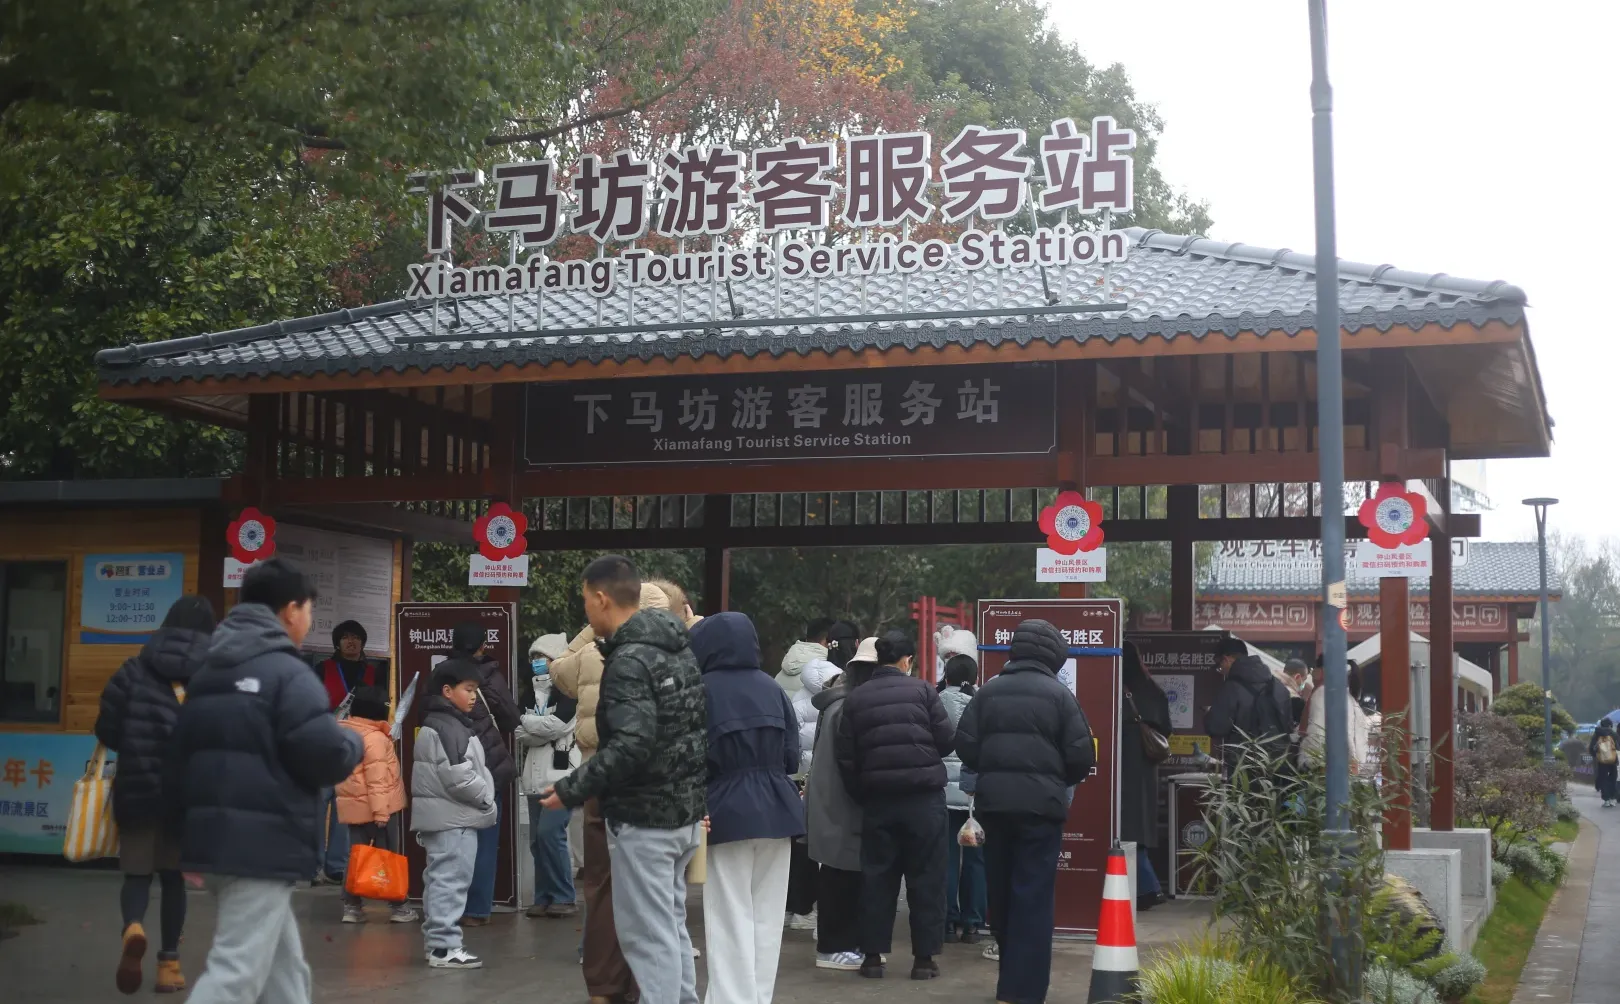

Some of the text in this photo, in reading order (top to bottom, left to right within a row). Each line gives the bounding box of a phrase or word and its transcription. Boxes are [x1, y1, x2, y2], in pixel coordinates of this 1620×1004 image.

[409, 118, 1134, 253] 下马坊游客服务站
[409, 230, 1124, 297] Xiamafang Tourist Service Station
[573, 378, 1001, 434] 下马坊游客服务站
[652, 432, 912, 452] Xiamafang Tourist Service Station
[137, 564, 166, 576] 营业点
[473, 571, 524, 579] 微信扫码预约和购票
[114, 587, 150, 598] 营业时间
[109, 602, 155, 611] 9:00-11:30
[105, 614, 156, 623] 12:00-17:00
[409, 629, 499, 643] 钟山风区
[995, 629, 1104, 644] 钟名胜区
[1142, 652, 1216, 665] 山风景名胜区
[3, 758, 55, 789] 年卡
